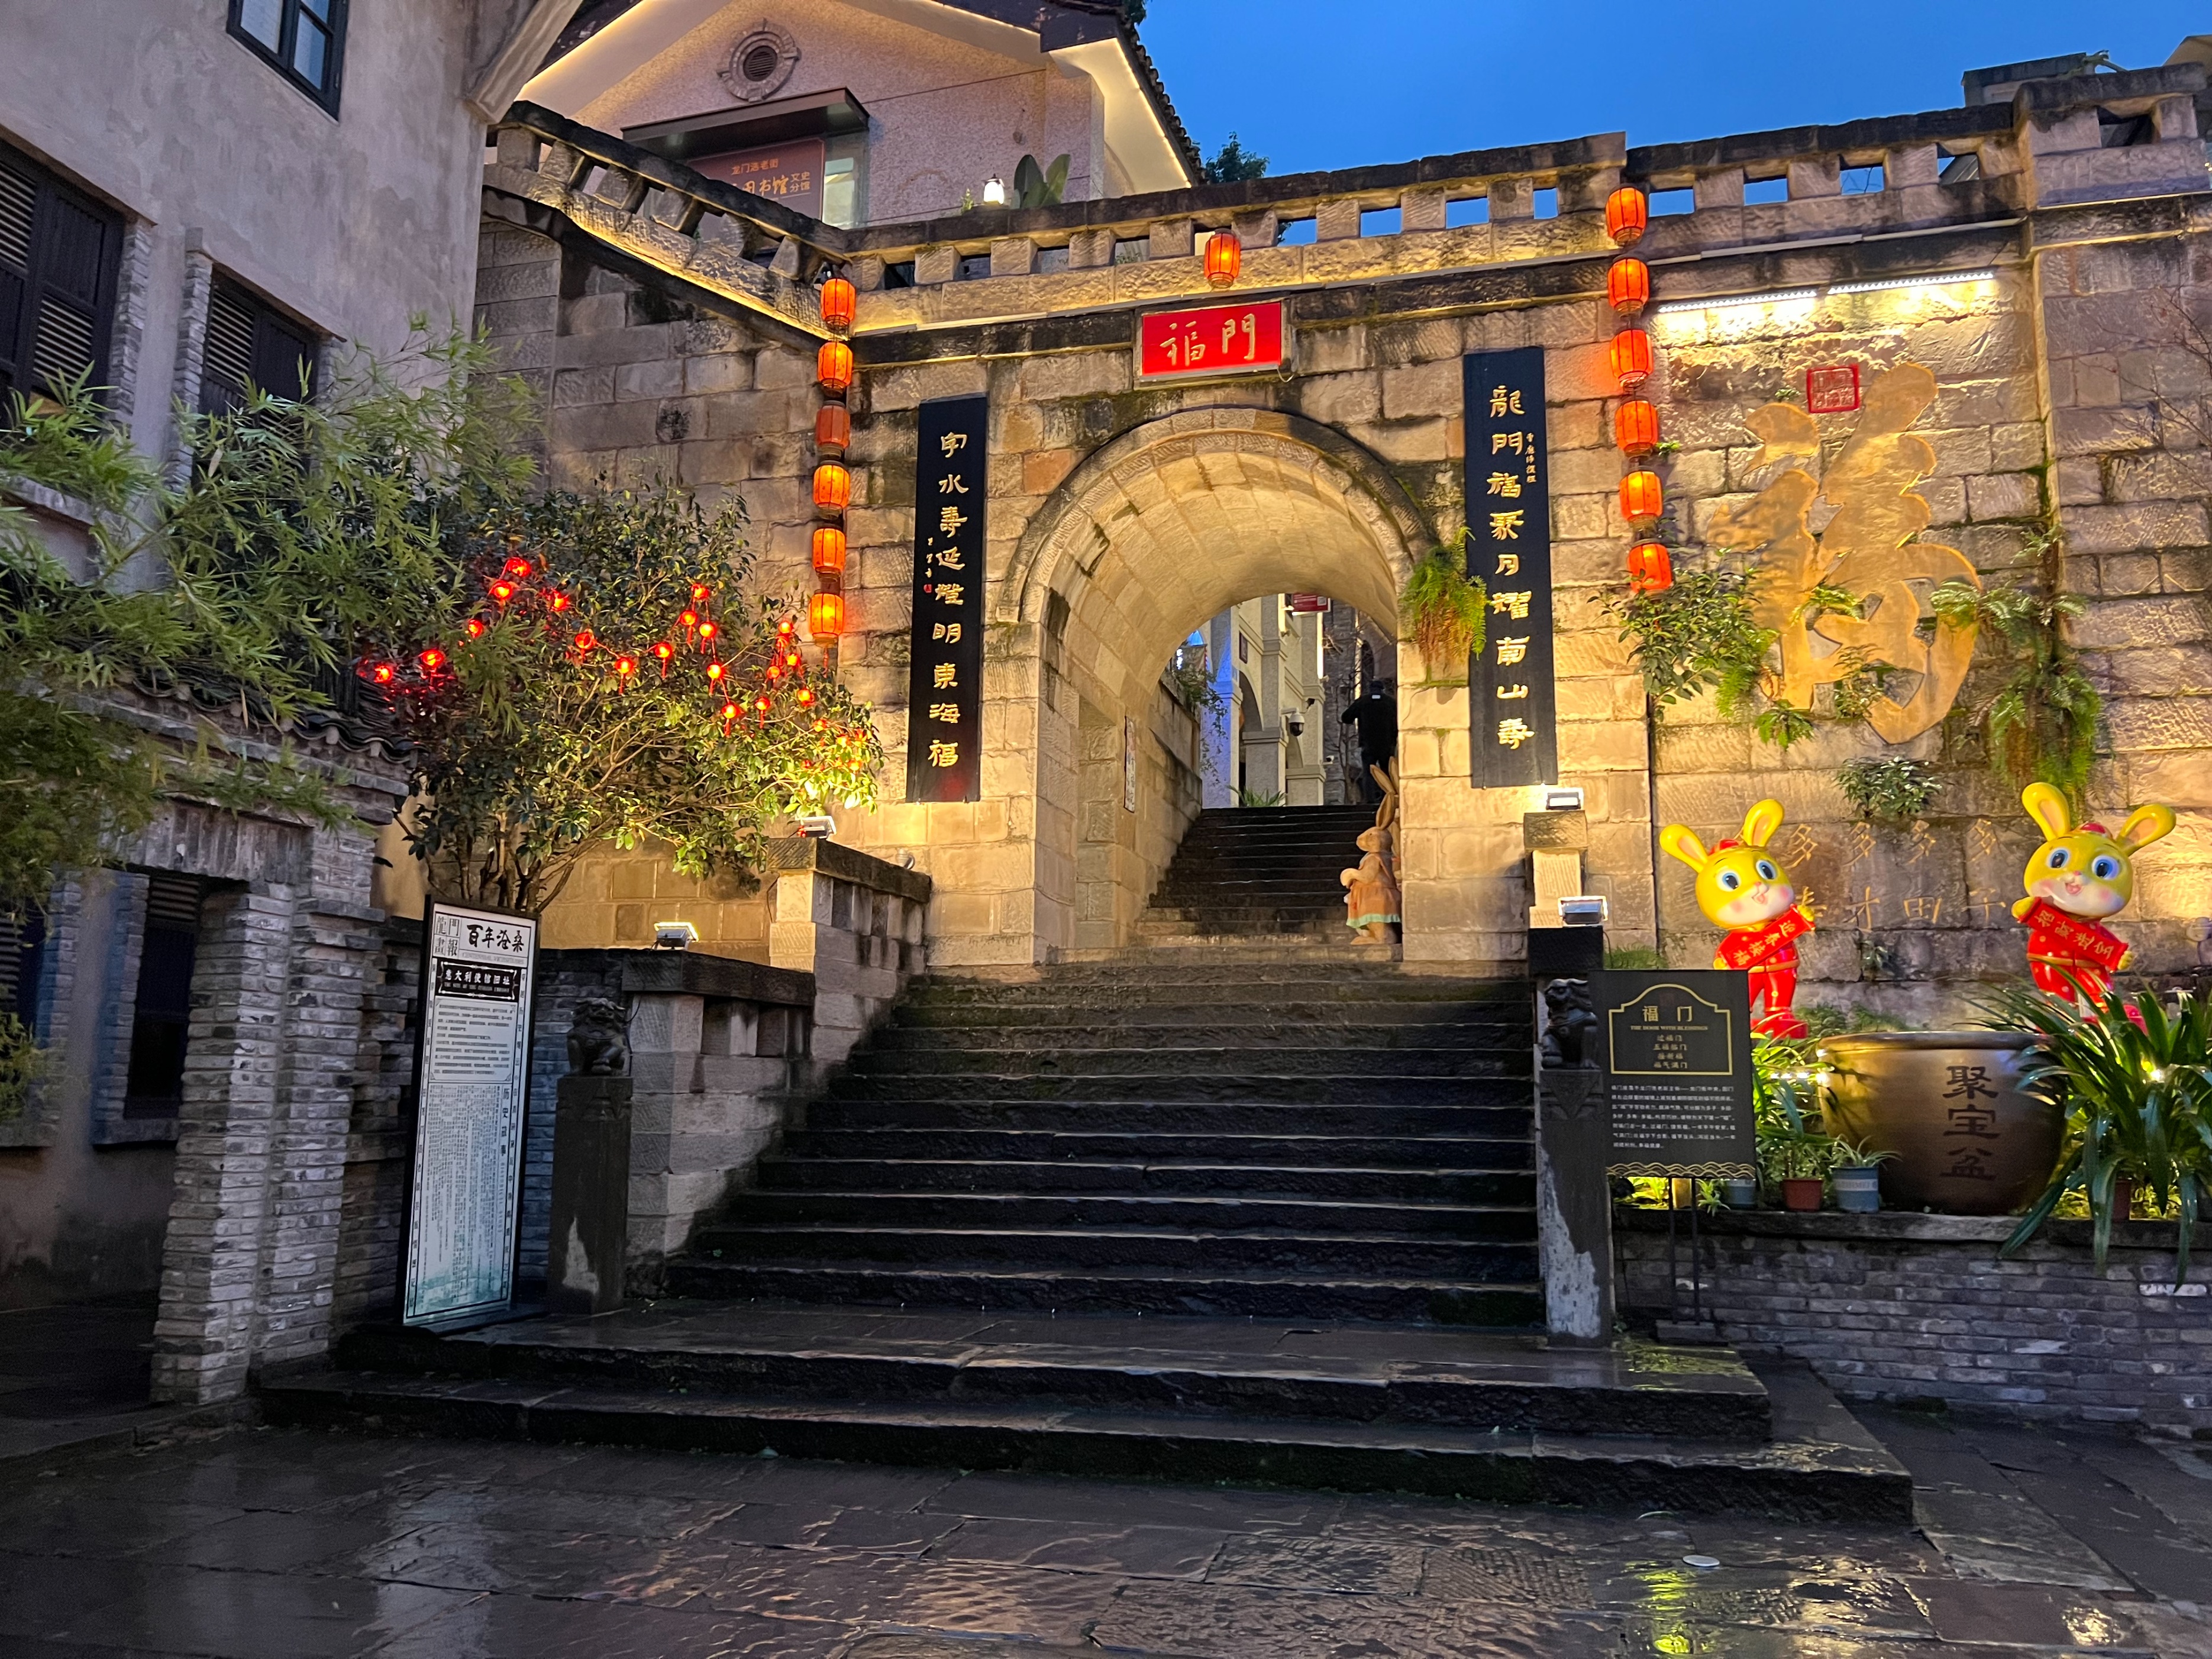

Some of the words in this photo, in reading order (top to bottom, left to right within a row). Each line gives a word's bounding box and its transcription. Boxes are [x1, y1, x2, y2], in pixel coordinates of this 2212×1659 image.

[731, 159, 779, 175] 龙门浩老街
[790, 172, 810, 182] 文史
[732, 175, 789, 196] 图书馆
[790, 181, 810, 193] 分馆
[1160, 313, 1255, 366] 福門
[467, 924, 524, 953] 百年沧桑
[445, 969, 510, 985] 意大利使馆旧址
[1642, 1006, 1693, 1022] 福门
[1939, 1066, 2000, 1181] 聚宝盆
